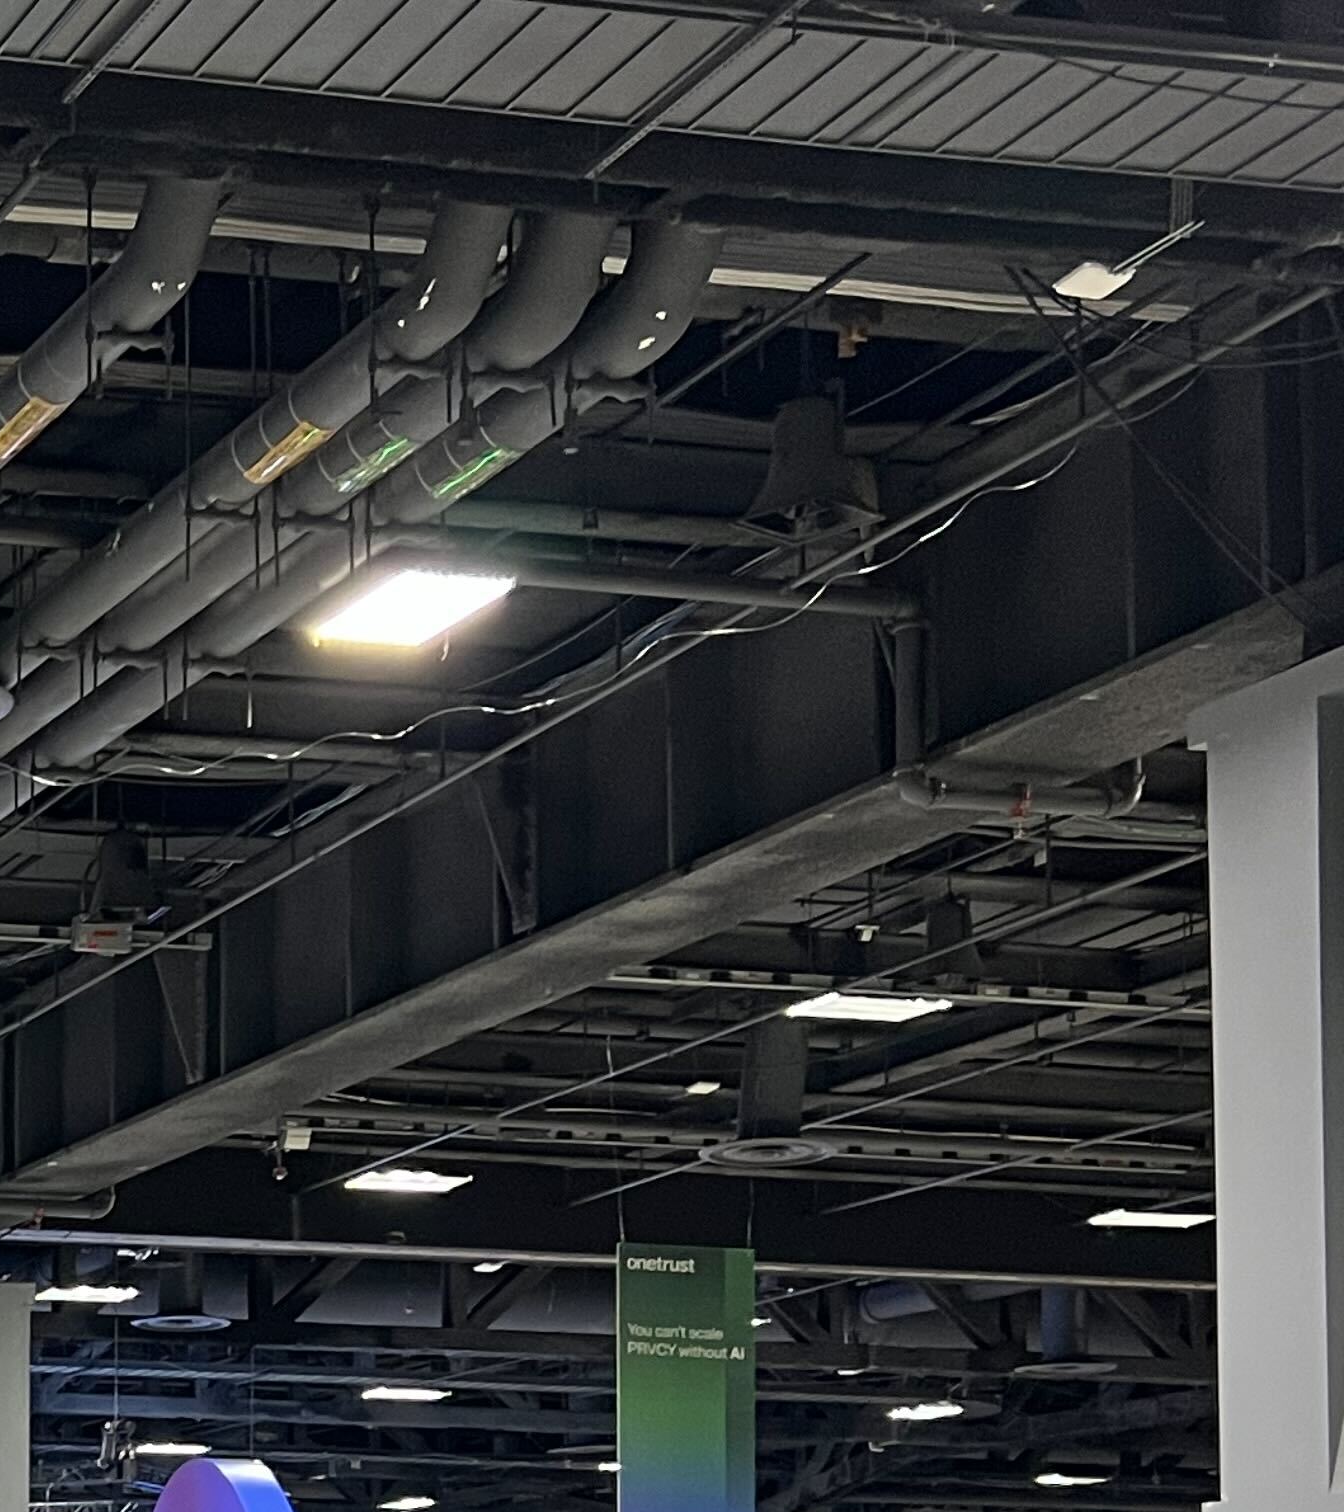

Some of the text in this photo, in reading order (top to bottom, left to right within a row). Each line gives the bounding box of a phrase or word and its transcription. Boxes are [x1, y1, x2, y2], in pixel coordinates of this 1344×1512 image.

[627, 1257, 695, 1273] onetrust
[627, 1322, 724, 1340] You can't scale
[679, 1346, 728, 1359] without
[730, 1346, 745, 1360] AI
